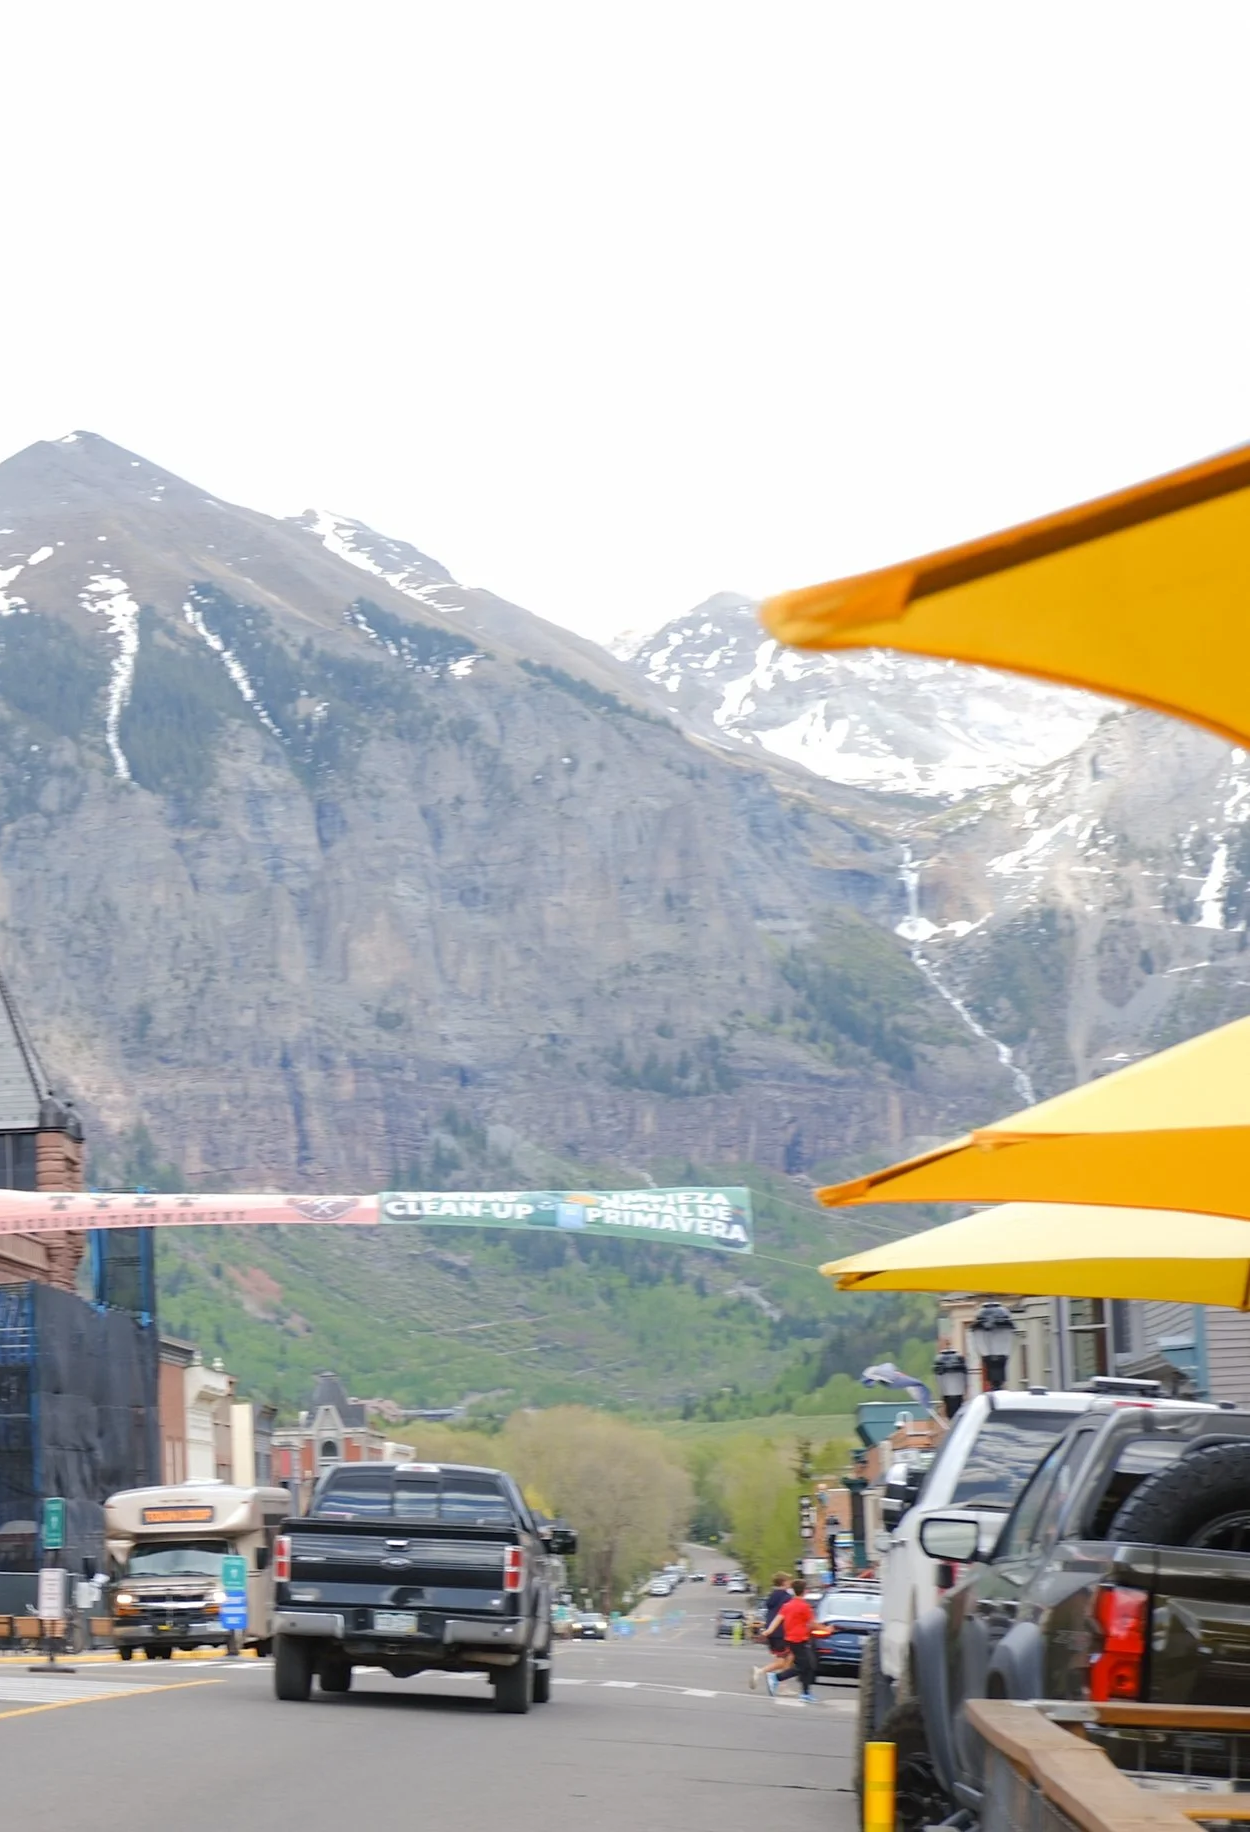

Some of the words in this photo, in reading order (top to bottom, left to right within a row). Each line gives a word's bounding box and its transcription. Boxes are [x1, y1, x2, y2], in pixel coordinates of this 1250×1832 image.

[385, 1201, 535, 1220] CLEAN-UP
[698, 1205, 733, 1222] DE
[586, 1207, 749, 1242] PRIMAVERA
